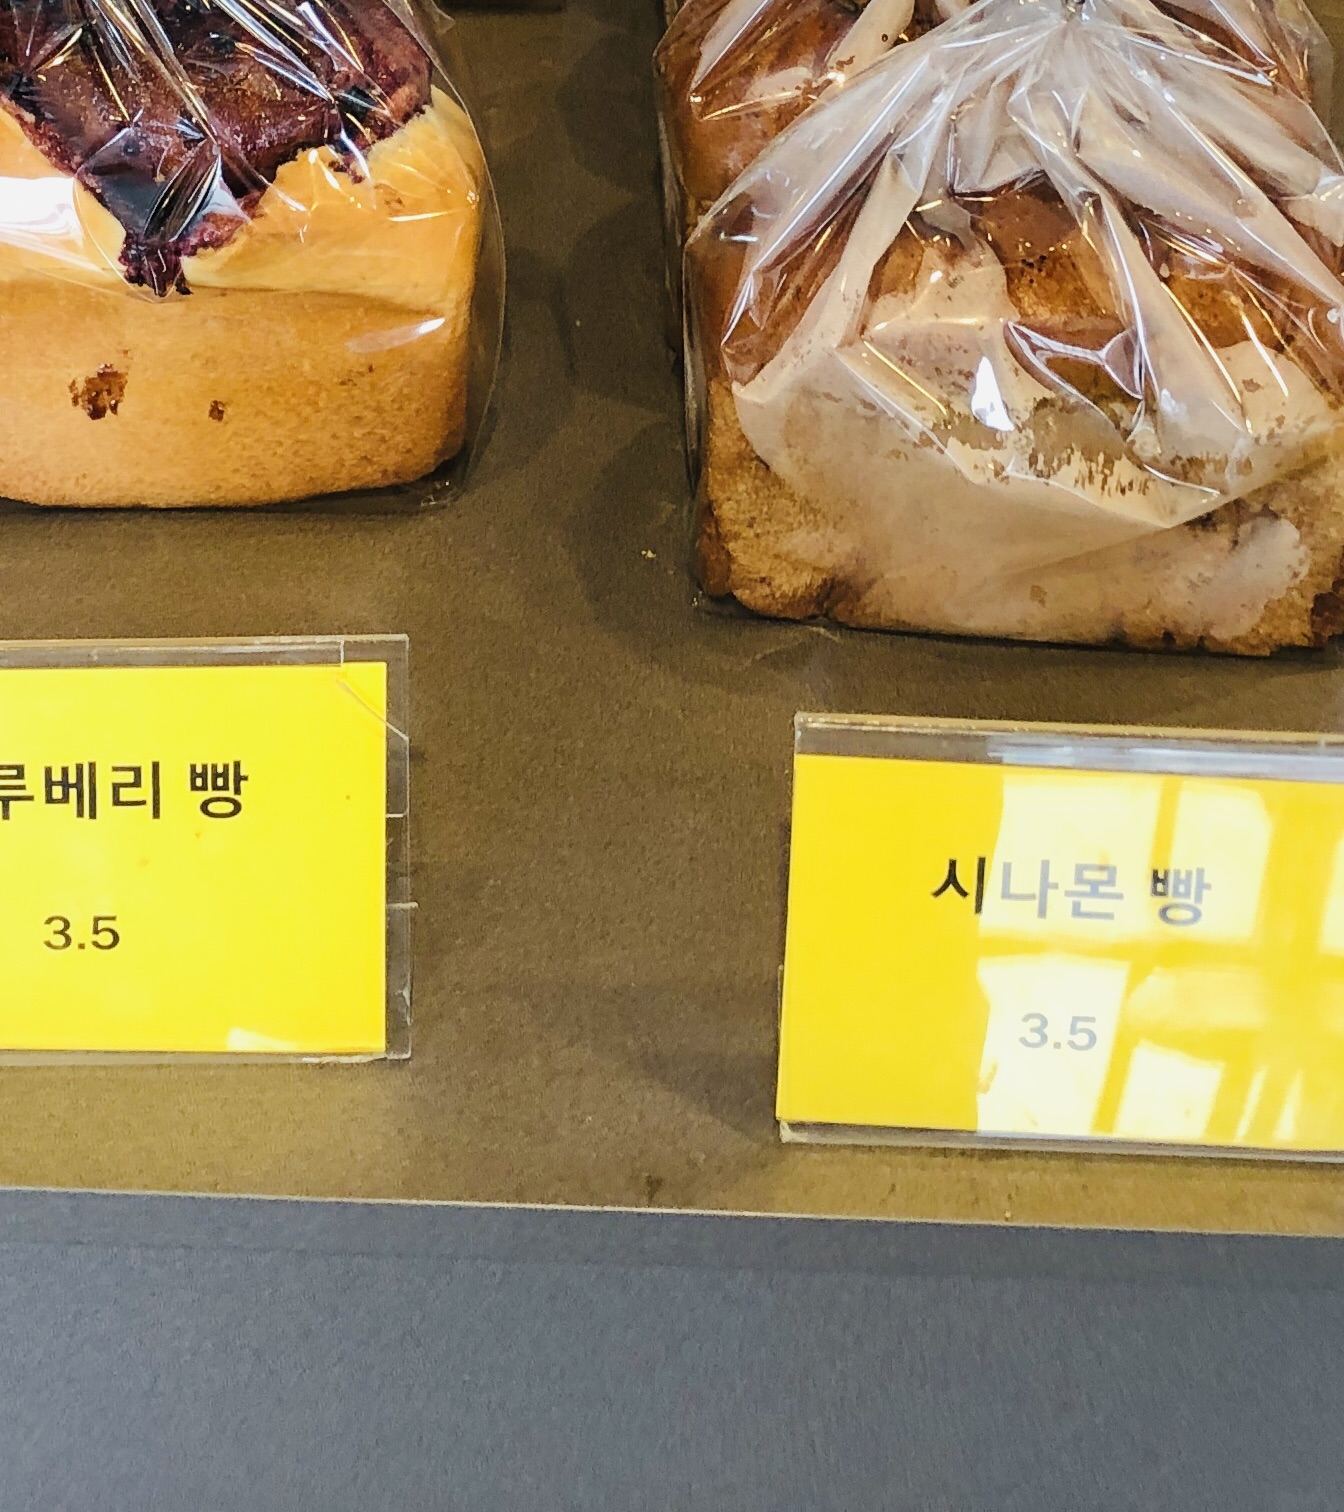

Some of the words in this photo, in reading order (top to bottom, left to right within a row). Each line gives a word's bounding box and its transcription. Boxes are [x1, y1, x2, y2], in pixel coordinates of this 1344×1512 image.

[188, 759, 250, 820] 빵
[930, 855, 1125, 922] 시나몬
[1150, 866, 1212, 928] 빵
[42, 914, 122, 952] 3.5
[1017, 1011, 1099, 1053] 3.5
